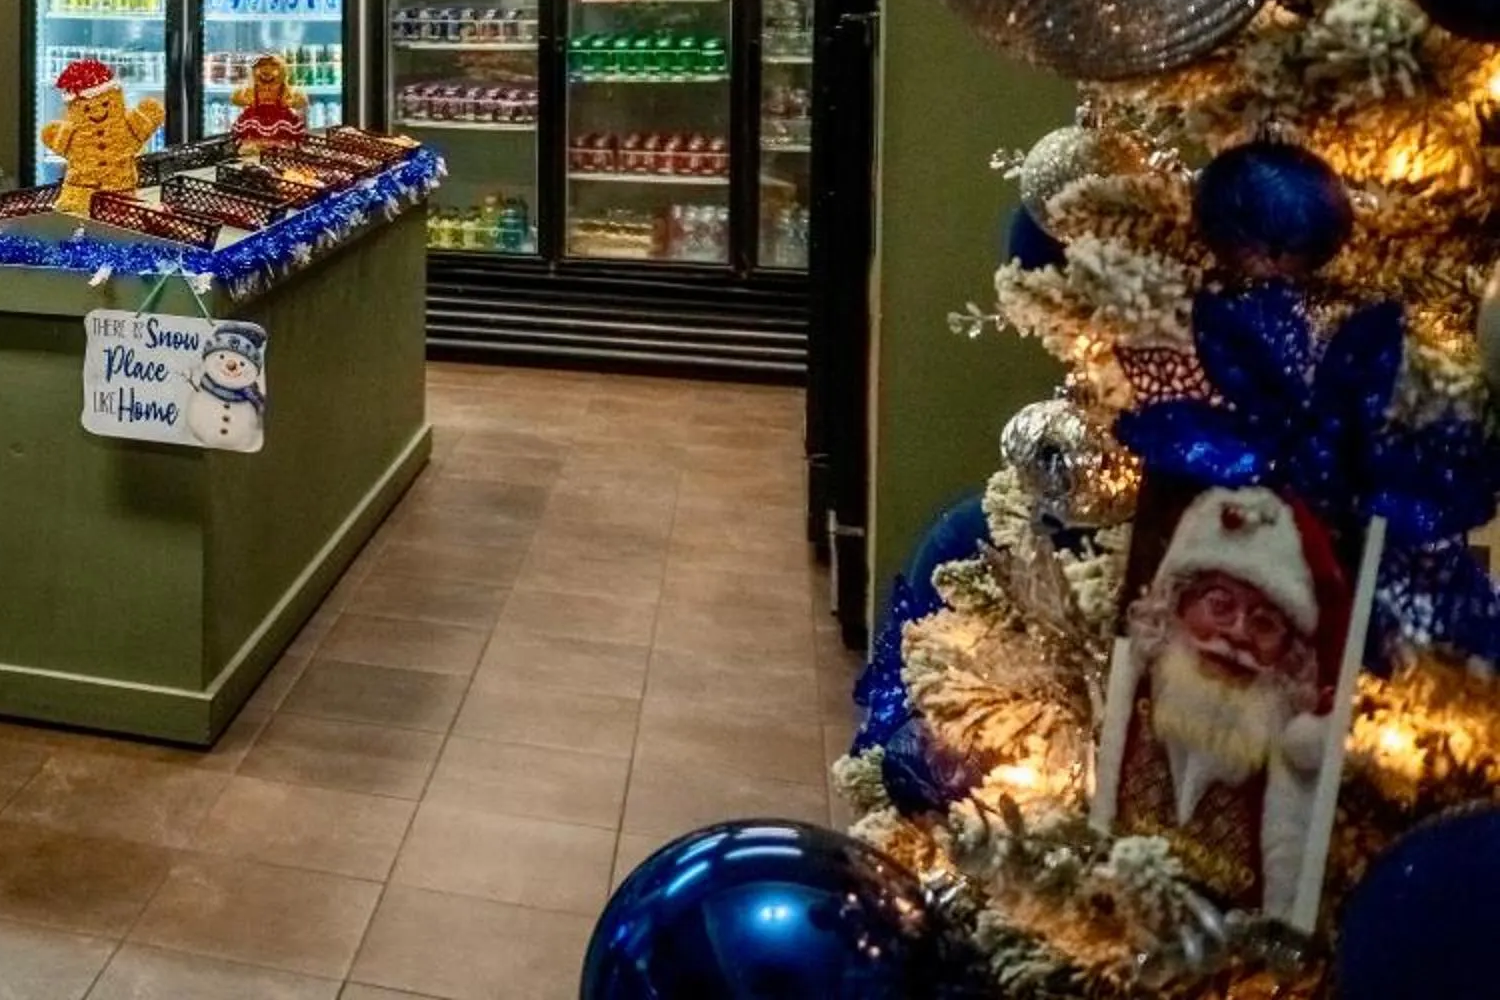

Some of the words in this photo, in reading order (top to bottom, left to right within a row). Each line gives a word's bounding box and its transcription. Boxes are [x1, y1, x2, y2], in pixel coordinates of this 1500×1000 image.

[92, 317, 126, 339] THERE
[145, 317, 200, 351] Snow
[103, 345, 169, 384] Place
[92, 390, 116, 416] LIKE
[117, 387, 179, 425] Home
